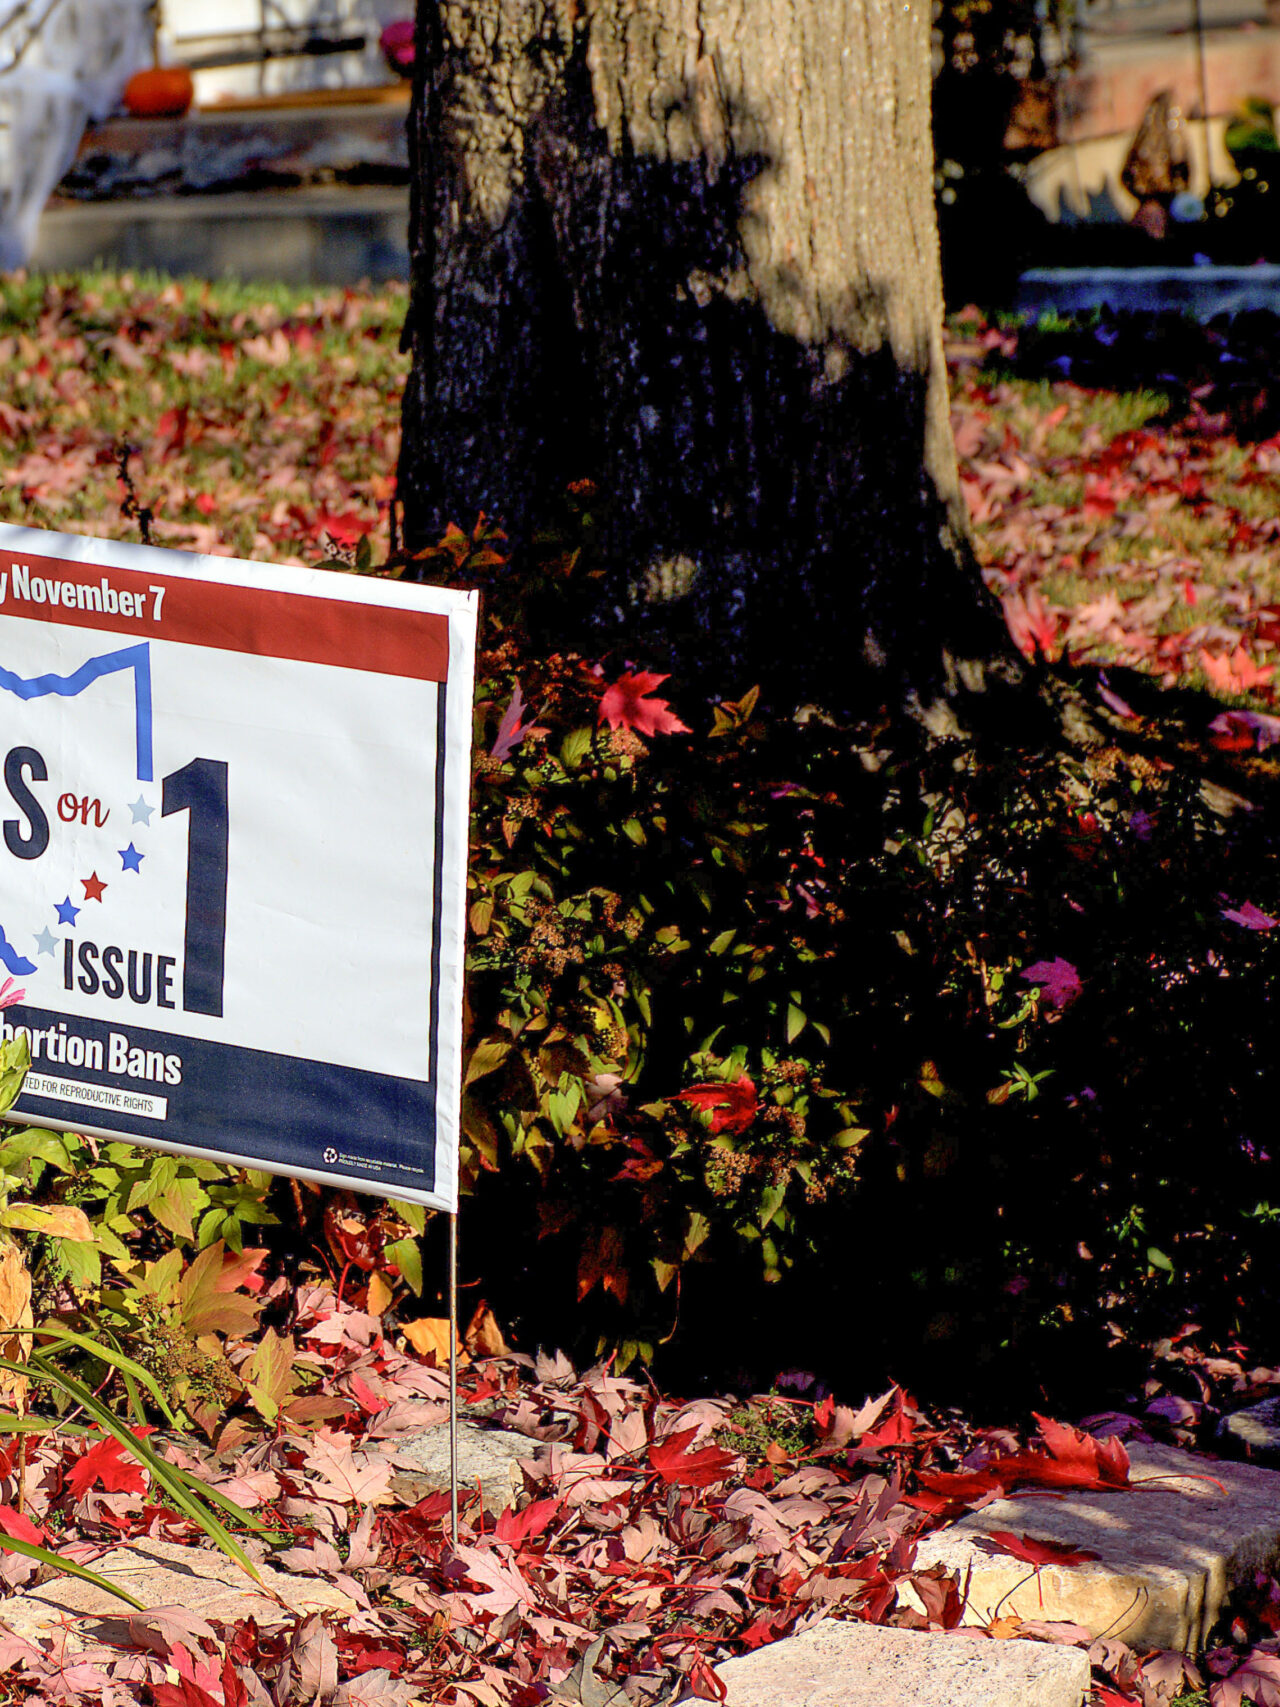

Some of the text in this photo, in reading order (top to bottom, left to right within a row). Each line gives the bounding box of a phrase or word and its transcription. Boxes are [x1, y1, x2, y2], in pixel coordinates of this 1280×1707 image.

[11, 563, 147, 619] November
[148, 585, 166, 622] 7
[57, 792, 110, 828] on
[64, 757, 229, 1018] ISSUE 1
[108, 1032, 183, 1086] Bans
[41, 1079, 58, 1094] FOR
[60, 1083, 122, 1108] REPRODUCTIVE
[123, 1095, 154, 1113] RIGHTS
